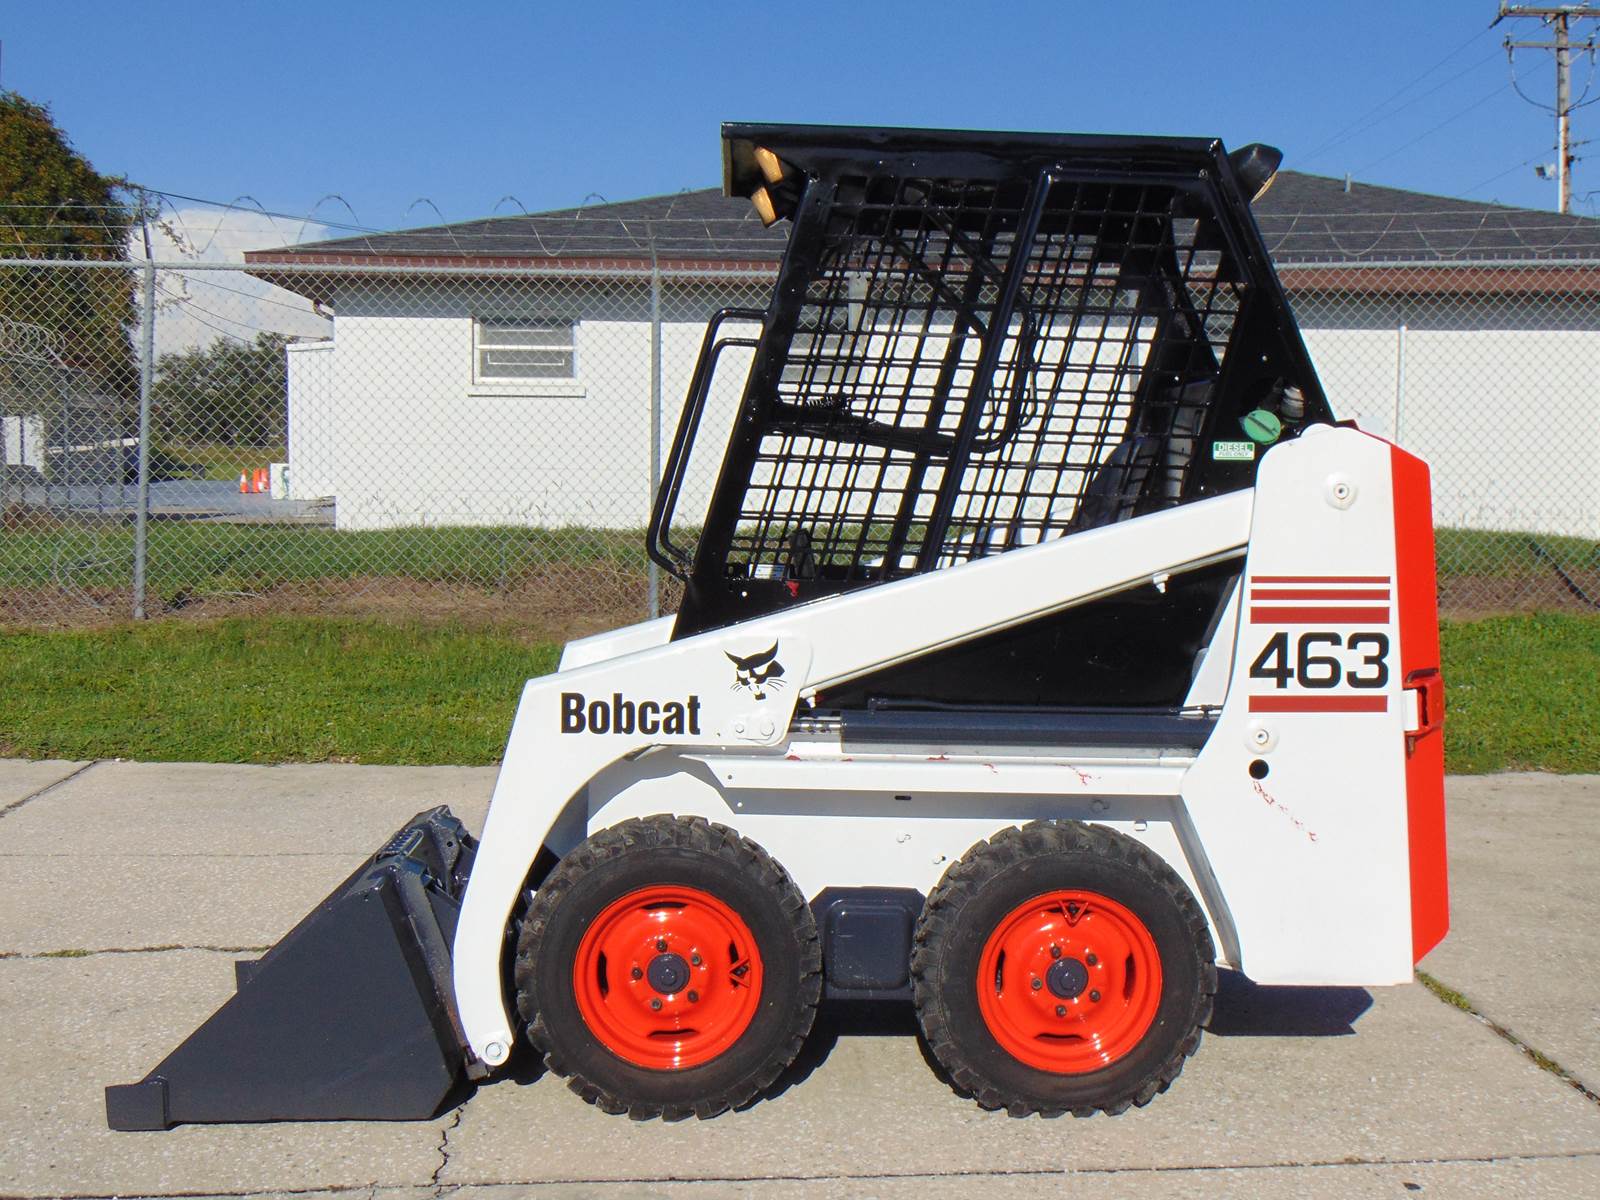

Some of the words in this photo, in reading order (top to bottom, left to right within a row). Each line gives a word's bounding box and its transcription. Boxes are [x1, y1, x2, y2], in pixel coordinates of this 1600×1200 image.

[1218, 443, 1248, 451] DIESEL
[1249, 632, 1389, 689] 463
[561, 692, 701, 735] Bobcat
